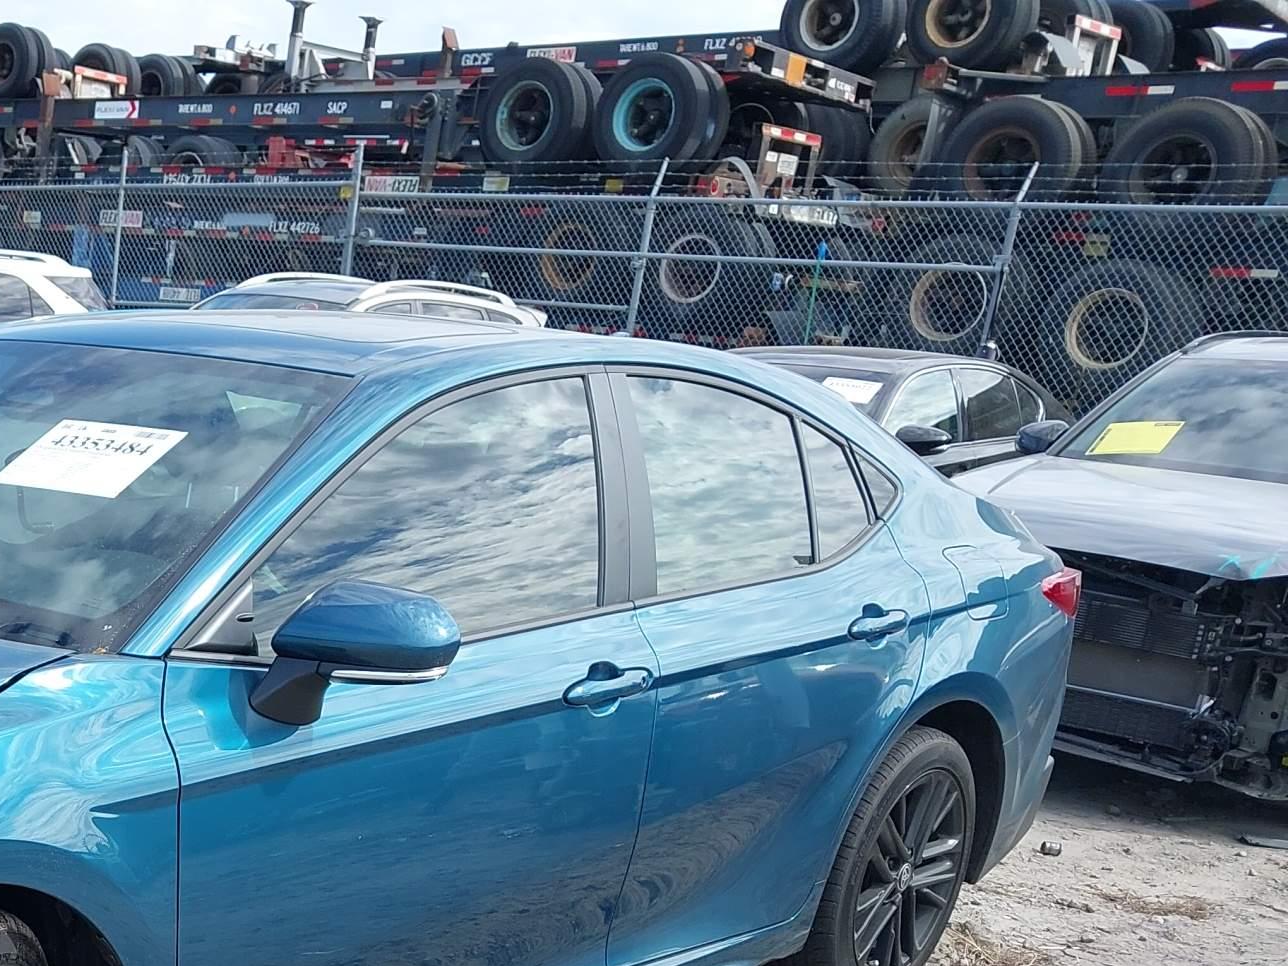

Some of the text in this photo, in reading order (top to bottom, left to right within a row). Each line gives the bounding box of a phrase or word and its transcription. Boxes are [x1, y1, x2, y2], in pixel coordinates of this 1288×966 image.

[703, 38, 727, 50] FLXZ
[326, 101, 348, 114] SACP
[51, 434, 154, 456] 43353484
